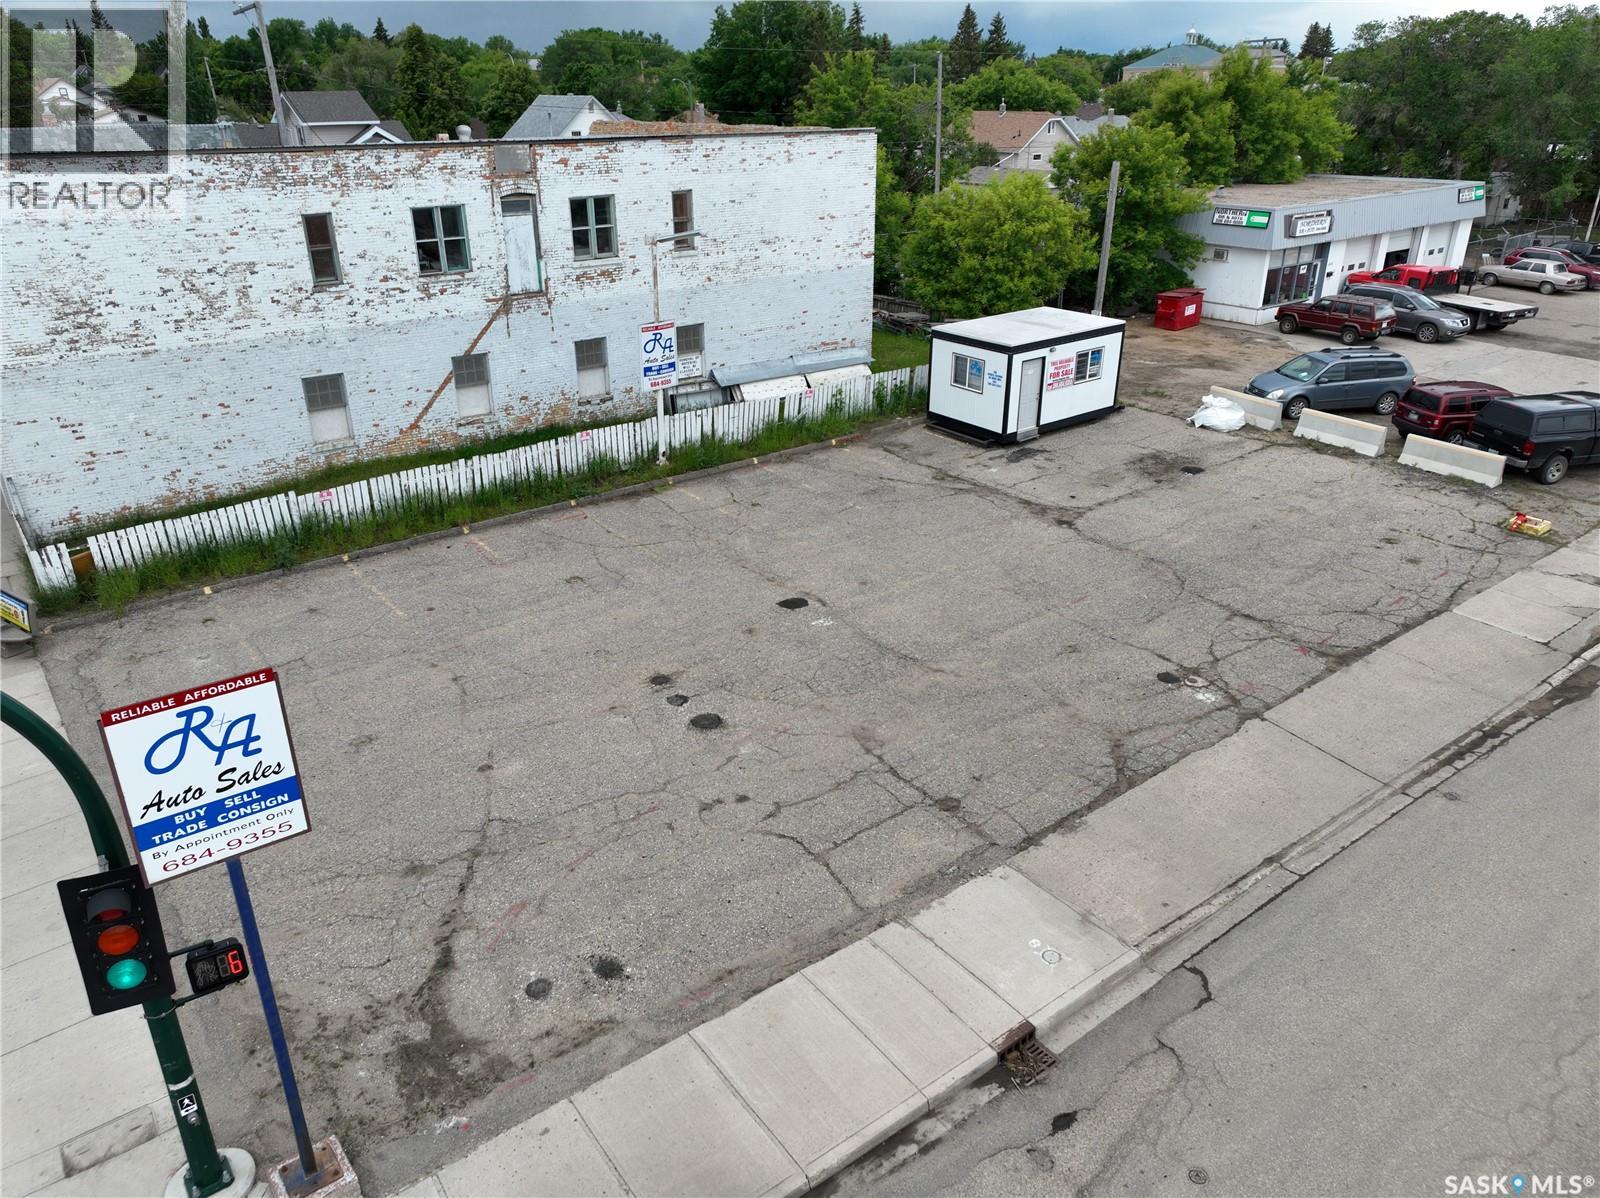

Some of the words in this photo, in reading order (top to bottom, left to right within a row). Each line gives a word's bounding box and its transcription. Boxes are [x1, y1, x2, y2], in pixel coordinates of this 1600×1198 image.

[644, 356, 659, 365] Auto
[660, 354, 675, 363] Sales
[1049, 371, 1060, 379] FOR
[1060, 368, 1074, 377] SALE
[111, 697, 176, 722] RELIABLE
[184, 672, 268, 702] AFFORDABLE
[140, 786, 206, 820] Auto
[215, 760, 286, 794] Sales
[174, 807, 207, 825] BUY
[224, 790, 261, 808] SELL
[152, 821, 208, 845] TRADE
[217, 793, 289, 824] CONSIGN
[152, 850, 168, 861] By
[175, 818, 261, 852] Appointment
[266, 807, 294, 821] Only
[162, 820, 293, 872] 684-9355
[227, 950, 243, 974] 6
